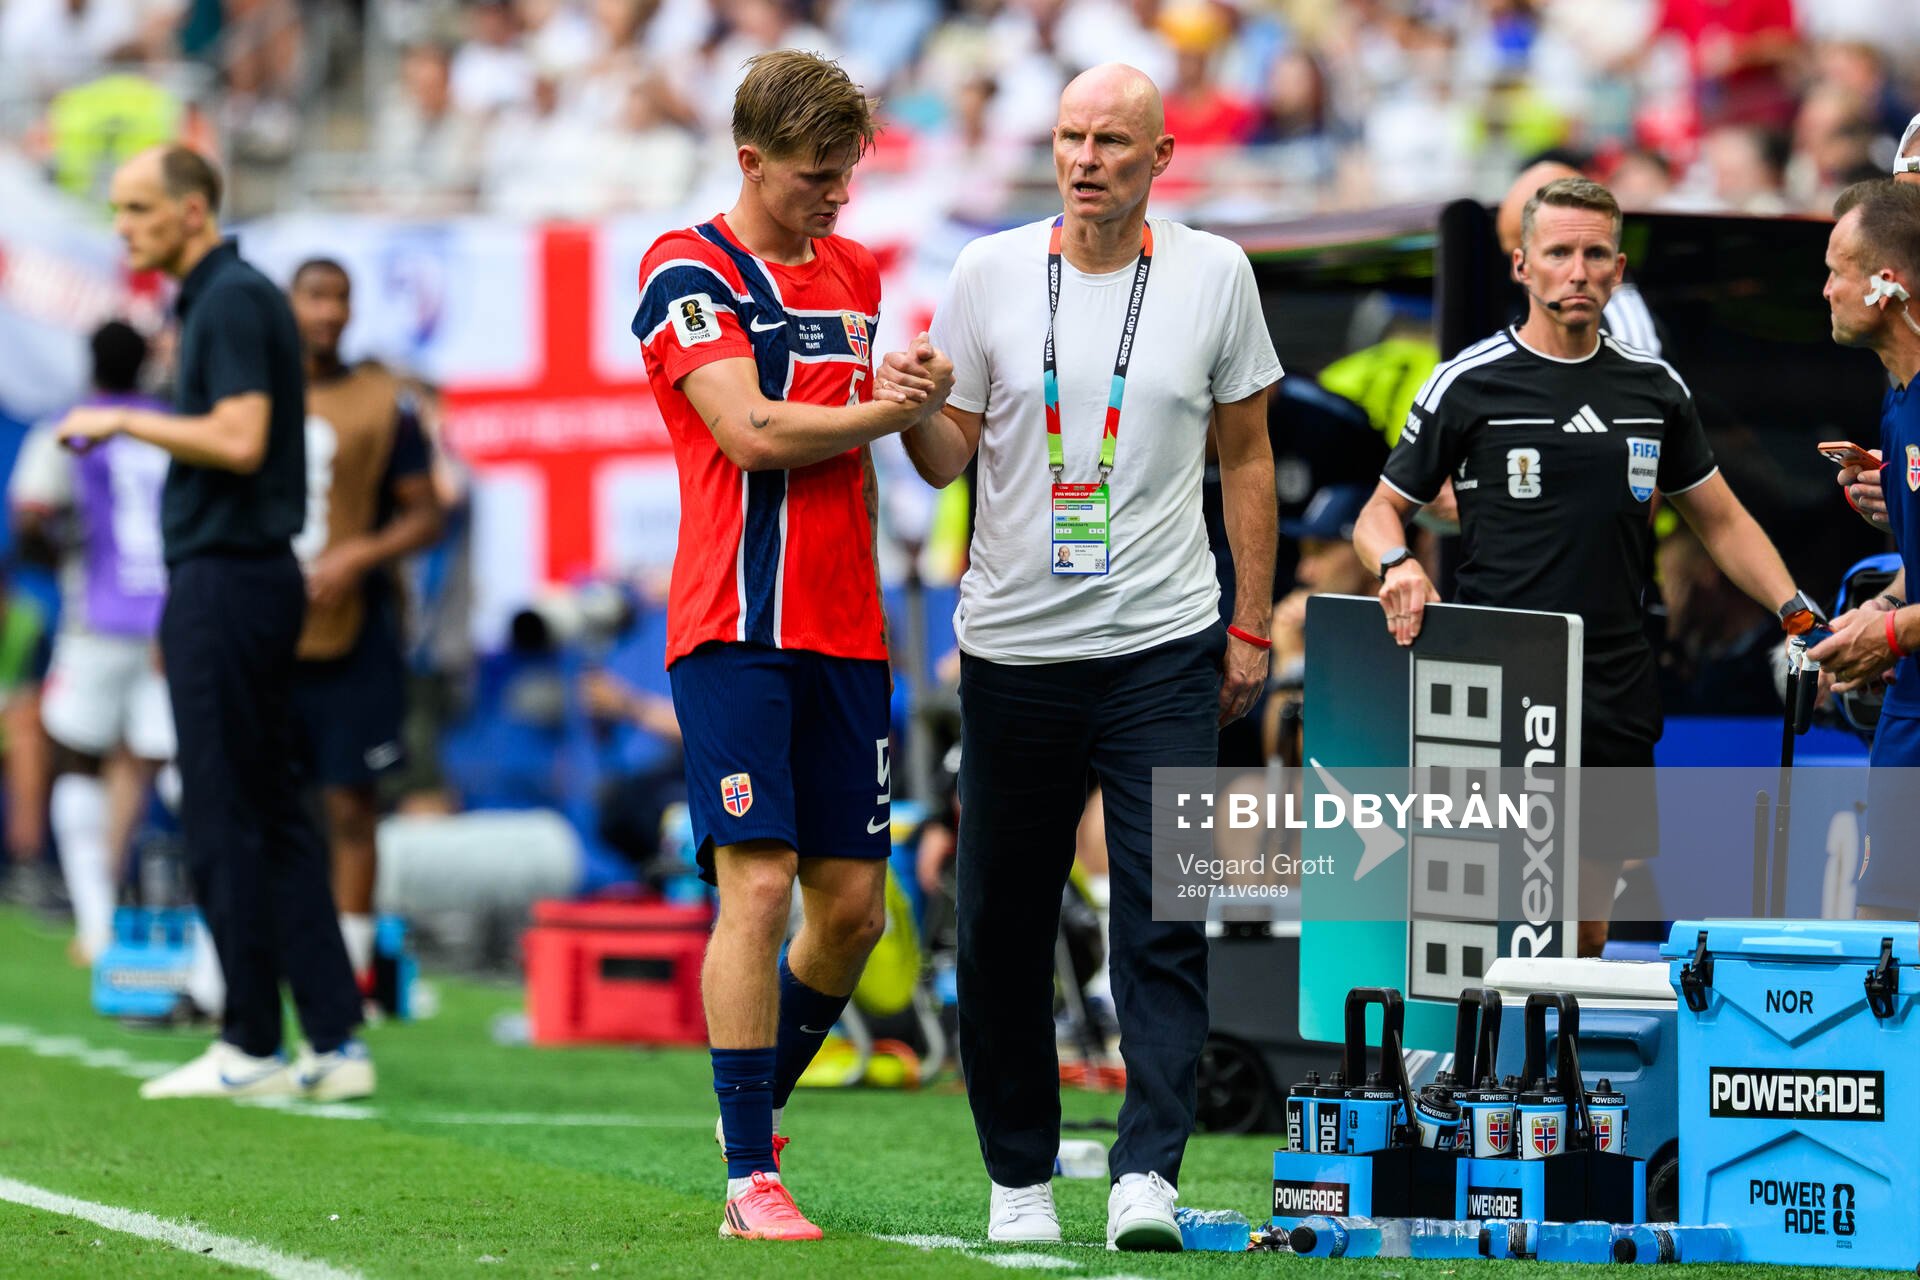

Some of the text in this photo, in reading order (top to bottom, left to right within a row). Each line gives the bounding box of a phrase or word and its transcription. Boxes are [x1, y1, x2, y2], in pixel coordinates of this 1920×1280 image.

[1050, 263, 1058, 292] 2026
[1118, 264, 1147, 366] FIFA WORLD CUP 2026
[1633, 443, 1658, 458] FIFA
[1511, 705, 1556, 959] Rexona
[1766, 990, 1813, 1014] NOR
[1712, 1074, 1877, 1115] POWERADE
[1275, 1187, 1343, 1212] POWERADE
[1468, 1194, 1517, 1217] WERADE
[1750, 1180, 1825, 1208] POWER
[1785, 1208, 1826, 1235] ADE
